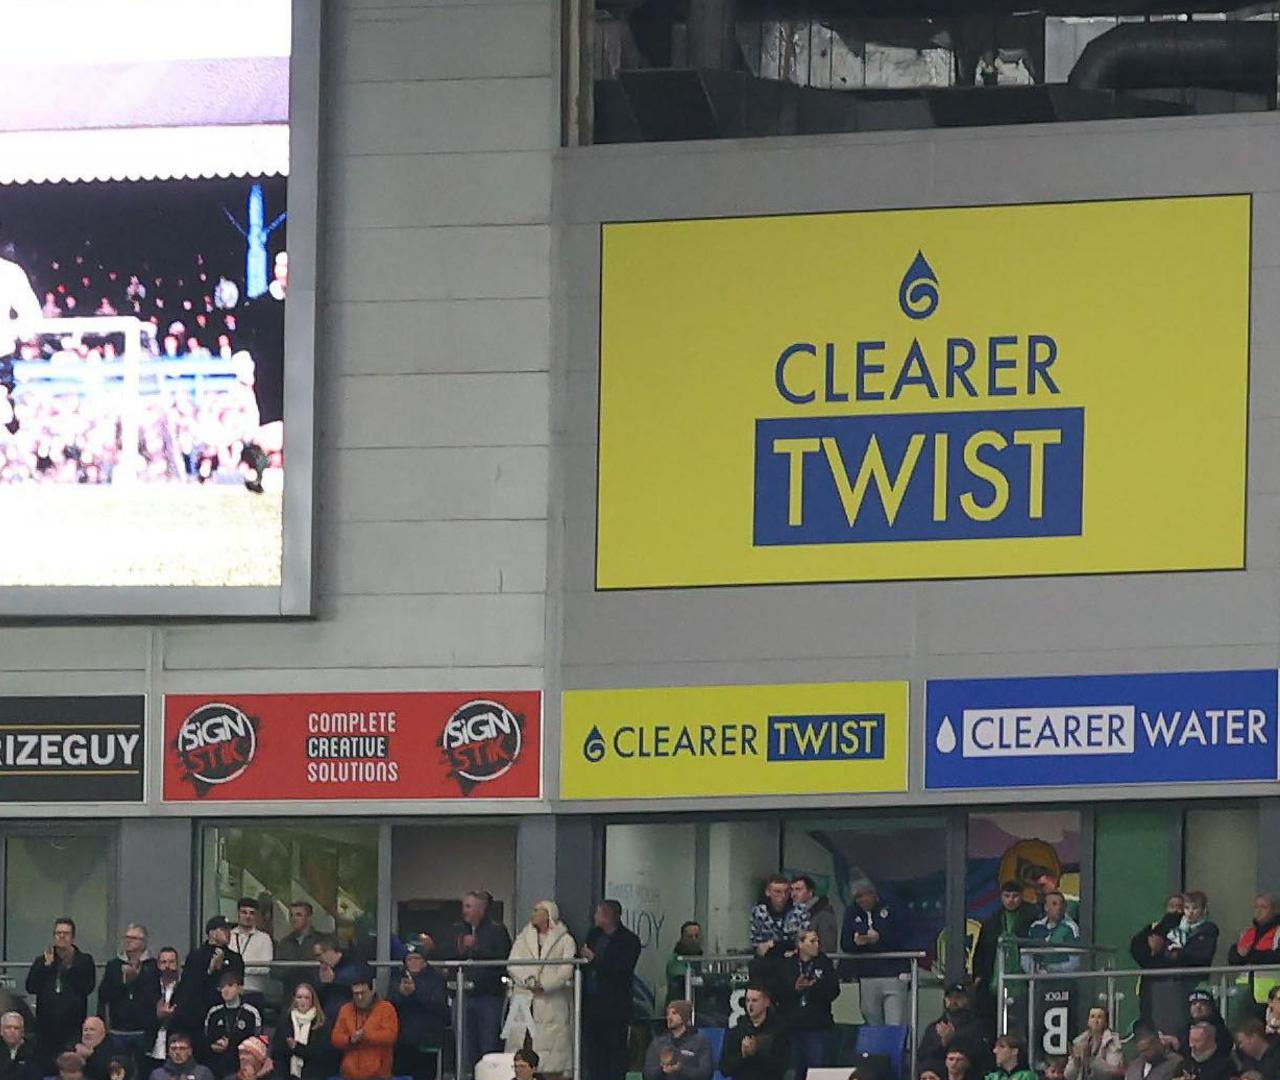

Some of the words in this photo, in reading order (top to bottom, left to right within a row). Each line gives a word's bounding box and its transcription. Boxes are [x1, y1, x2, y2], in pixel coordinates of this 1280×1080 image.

[775, 335, 1060, 405] CLEARER
[773, 428, 1061, 528] TWIST
[308, 712, 396, 733] COMPLETE
[613, 724, 758, 759] CLEARER
[773, 720, 878, 755] TWIST
[971, 713, 1126, 751] CLEARER
[1140, 708, 1268, 749] WATER
[308, 737, 385, 757] CREATIVE
[307, 761, 398, 782] SOLUTIONS
